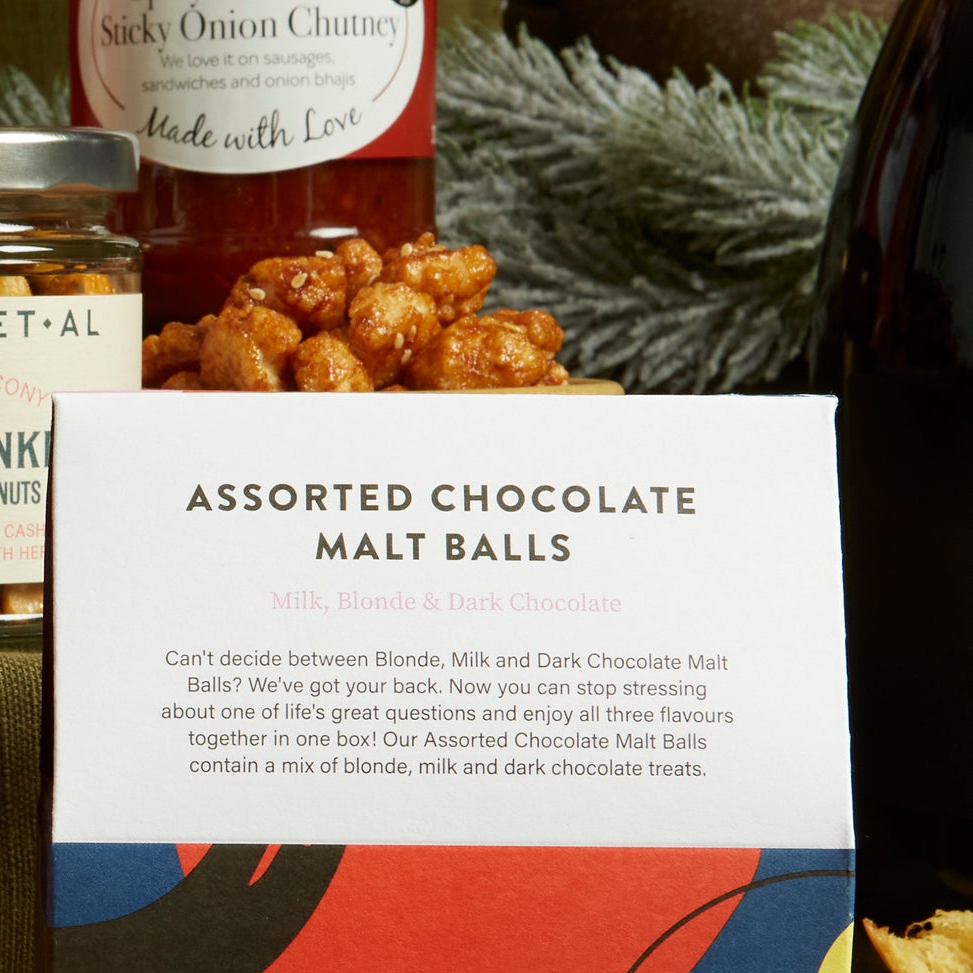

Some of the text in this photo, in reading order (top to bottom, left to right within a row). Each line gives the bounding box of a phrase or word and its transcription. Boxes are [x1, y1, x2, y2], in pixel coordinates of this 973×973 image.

[101, 13, 172, 53] Sticky
[288, 5, 400, 47] Chutney
[160, 50, 335, 69] We love it on sausages,
[141, 72, 356, 92] sandwiches and onion bhajis
[136, 106, 362, 150] Made with Love
[186, 483, 696, 515] ASSORTED CHOCOLATE
[316, 532, 571, 562] MALT BALLS
[271, 590, 622, 614] Milk, Blonde & Dark Chocolate
[165, 650, 728, 670] Can't decide between Blonde, Milk and Dark Chocolate Malt
[188, 676, 707, 701] Balls? We've got your back. Now you can stop stressing
[161, 703, 734, 726] about one of life's great questions and enjoy all three flavours
[188, 730, 707, 750] together in one box! Our Assorted Chocolate Malt Balls
[189, 756, 707, 777] contain a mix of blonde, milk and dark chocolate treats.
